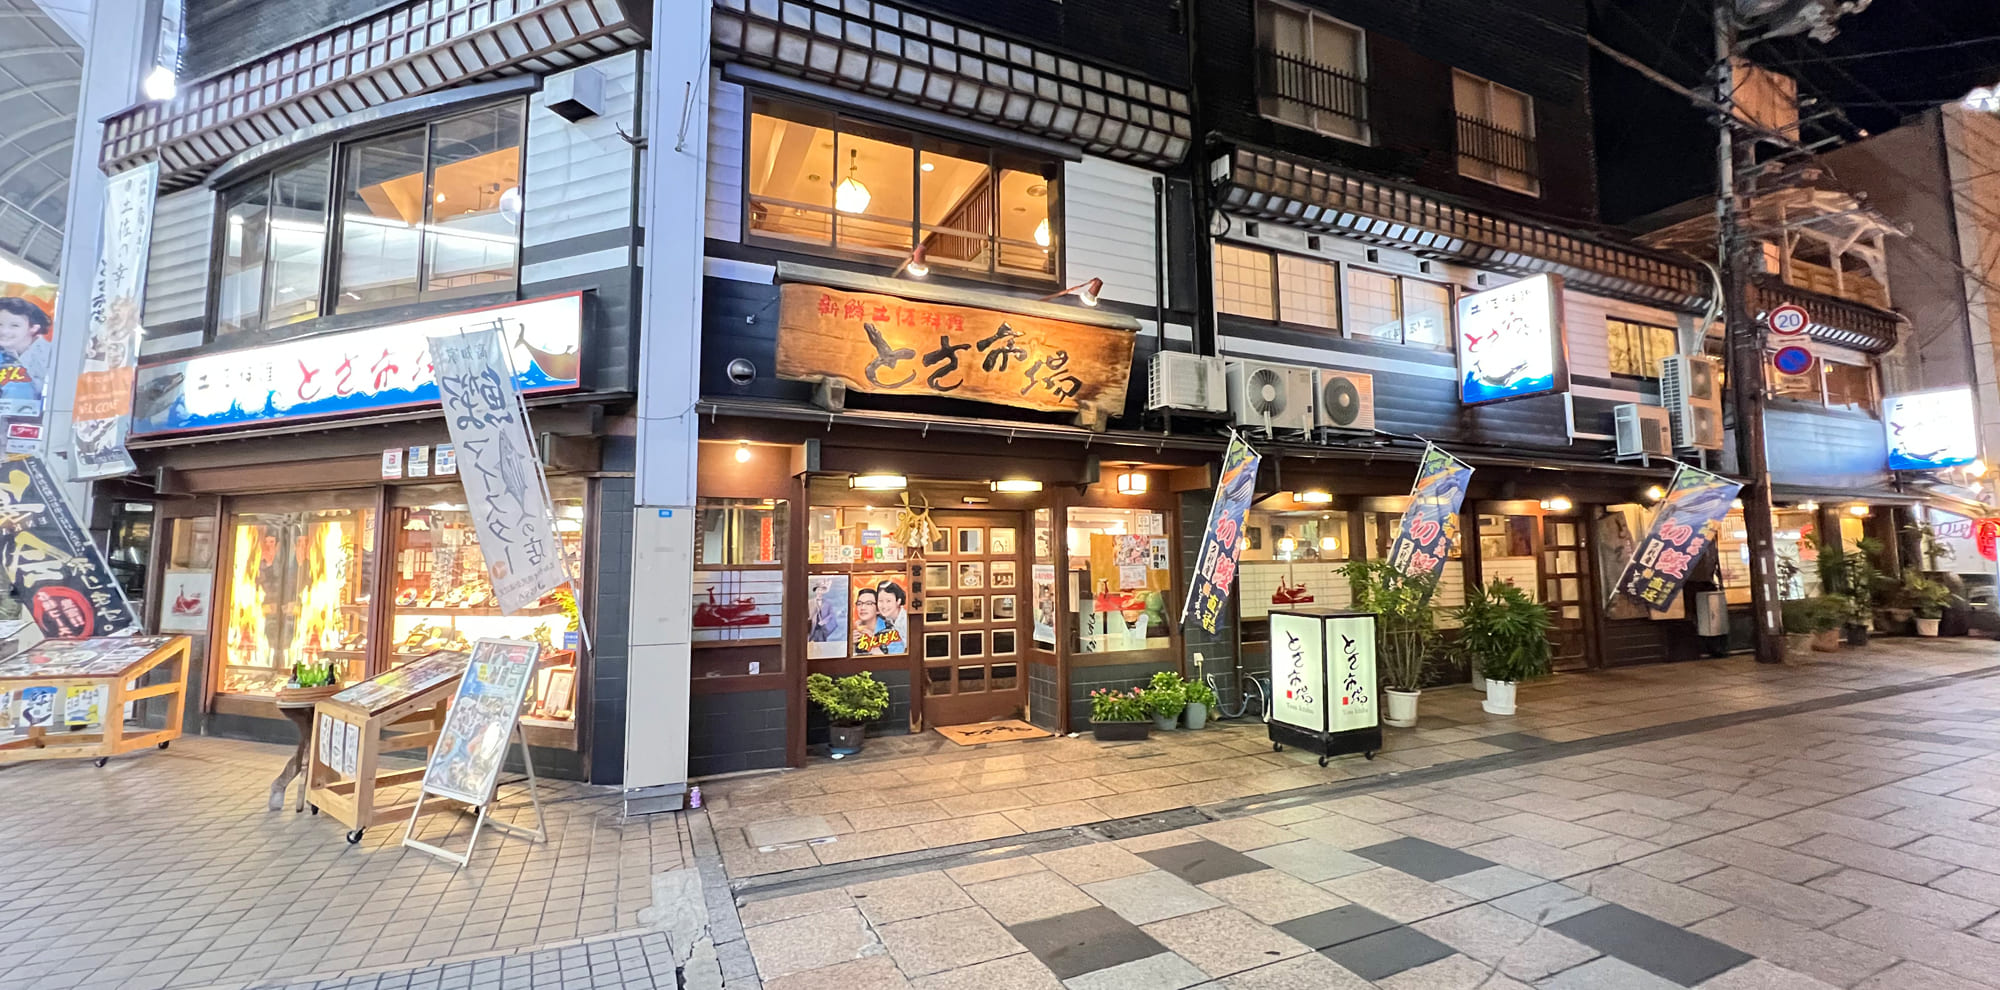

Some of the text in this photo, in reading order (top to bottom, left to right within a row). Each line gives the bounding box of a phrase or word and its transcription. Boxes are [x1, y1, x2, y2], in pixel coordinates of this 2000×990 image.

[818, 295, 965, 332] 新鮮土佐料理
[1778, 313, 1800, 328] 20
[863, 322, 1082, 403] とさ市場
[910, 564, 923, 611] 営業中
[1286, 629, 1314, 705] とさ市場
[1341, 633, 1368, 705] とさ市場
